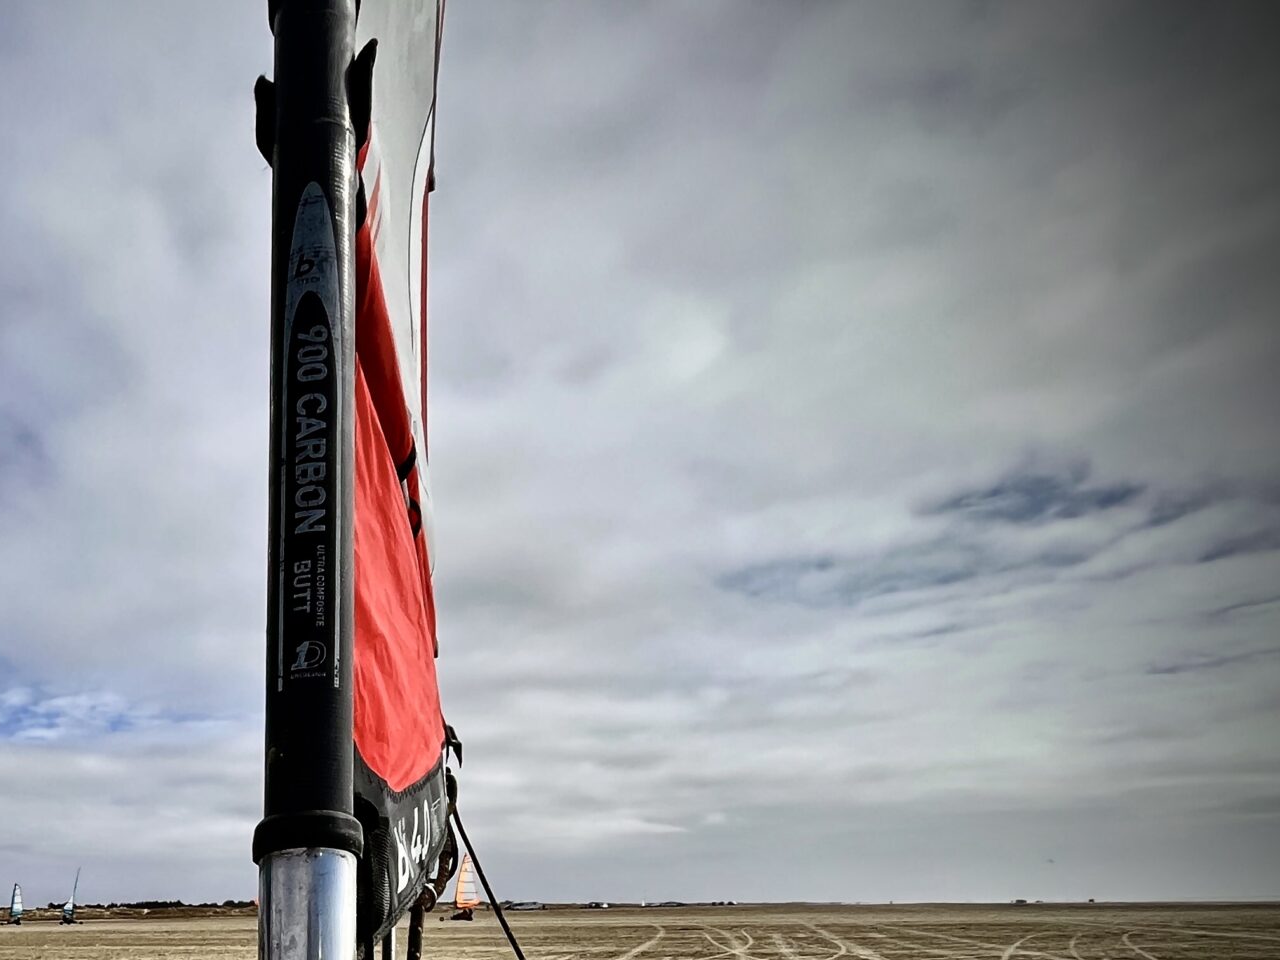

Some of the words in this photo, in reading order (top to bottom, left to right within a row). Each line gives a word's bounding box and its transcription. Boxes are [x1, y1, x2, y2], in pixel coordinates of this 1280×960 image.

[296, 324, 329, 383] 900
[294, 392, 328, 535] CARBON
[293, 559, 312, 613] BUTT
[315, 544, 326, 574] ULTRA
[315, 575, 326, 627] COMPOSITE
